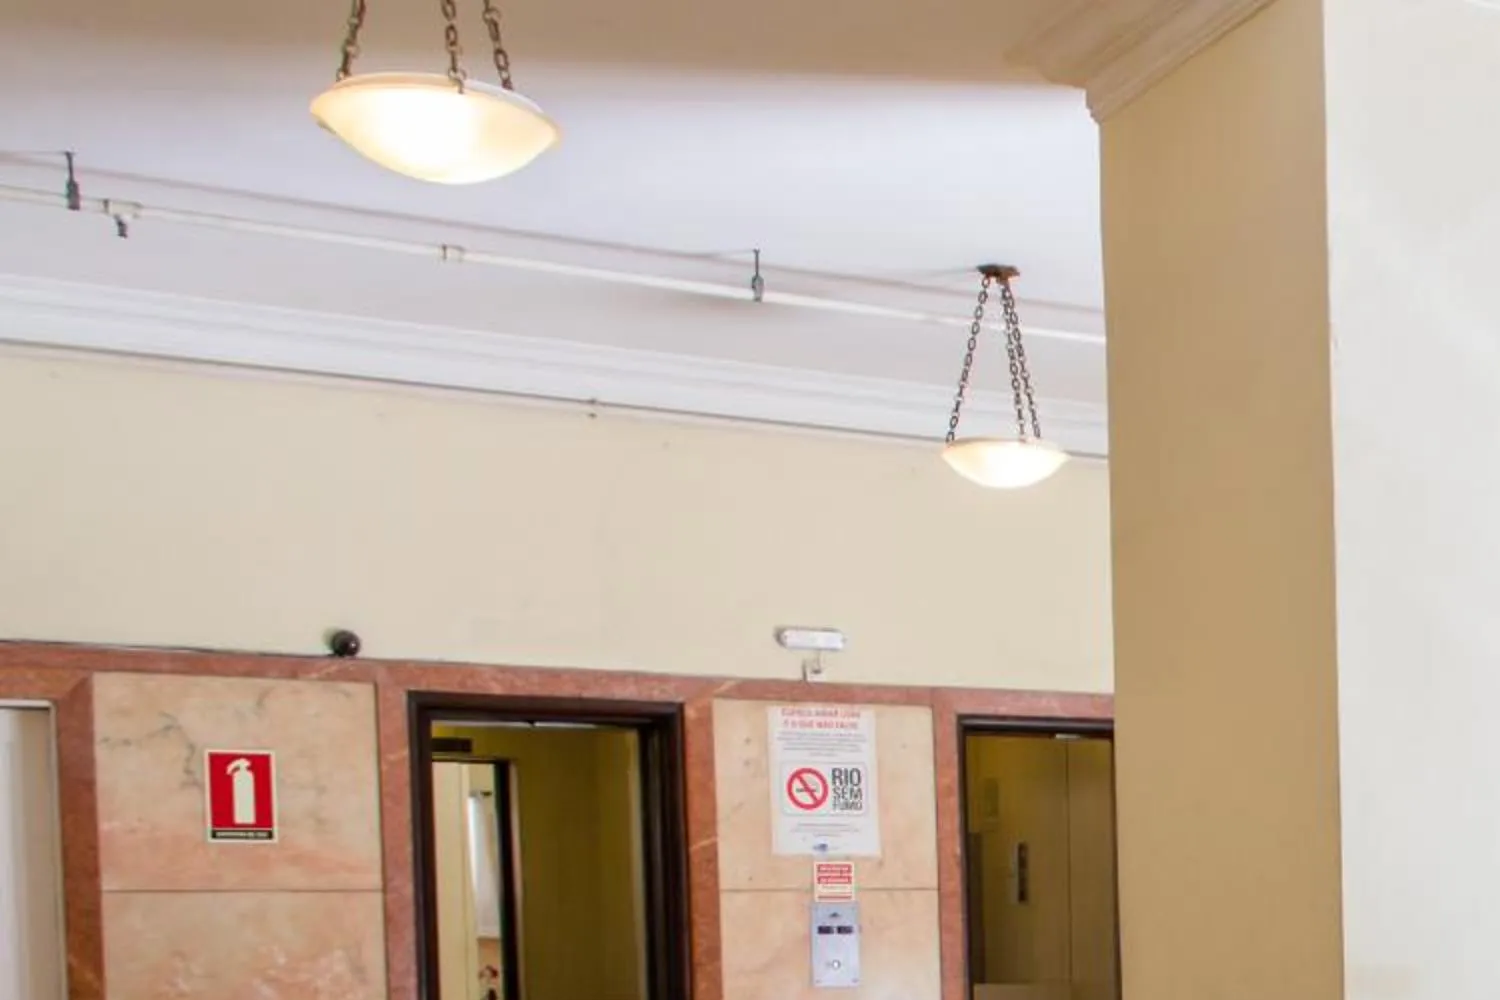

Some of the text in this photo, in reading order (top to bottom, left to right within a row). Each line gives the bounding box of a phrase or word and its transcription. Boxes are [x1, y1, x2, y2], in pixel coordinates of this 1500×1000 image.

[831, 767, 862, 787] RIO
[832, 787, 863, 801] SEM
[832, 800, 863, 811] FUMO
